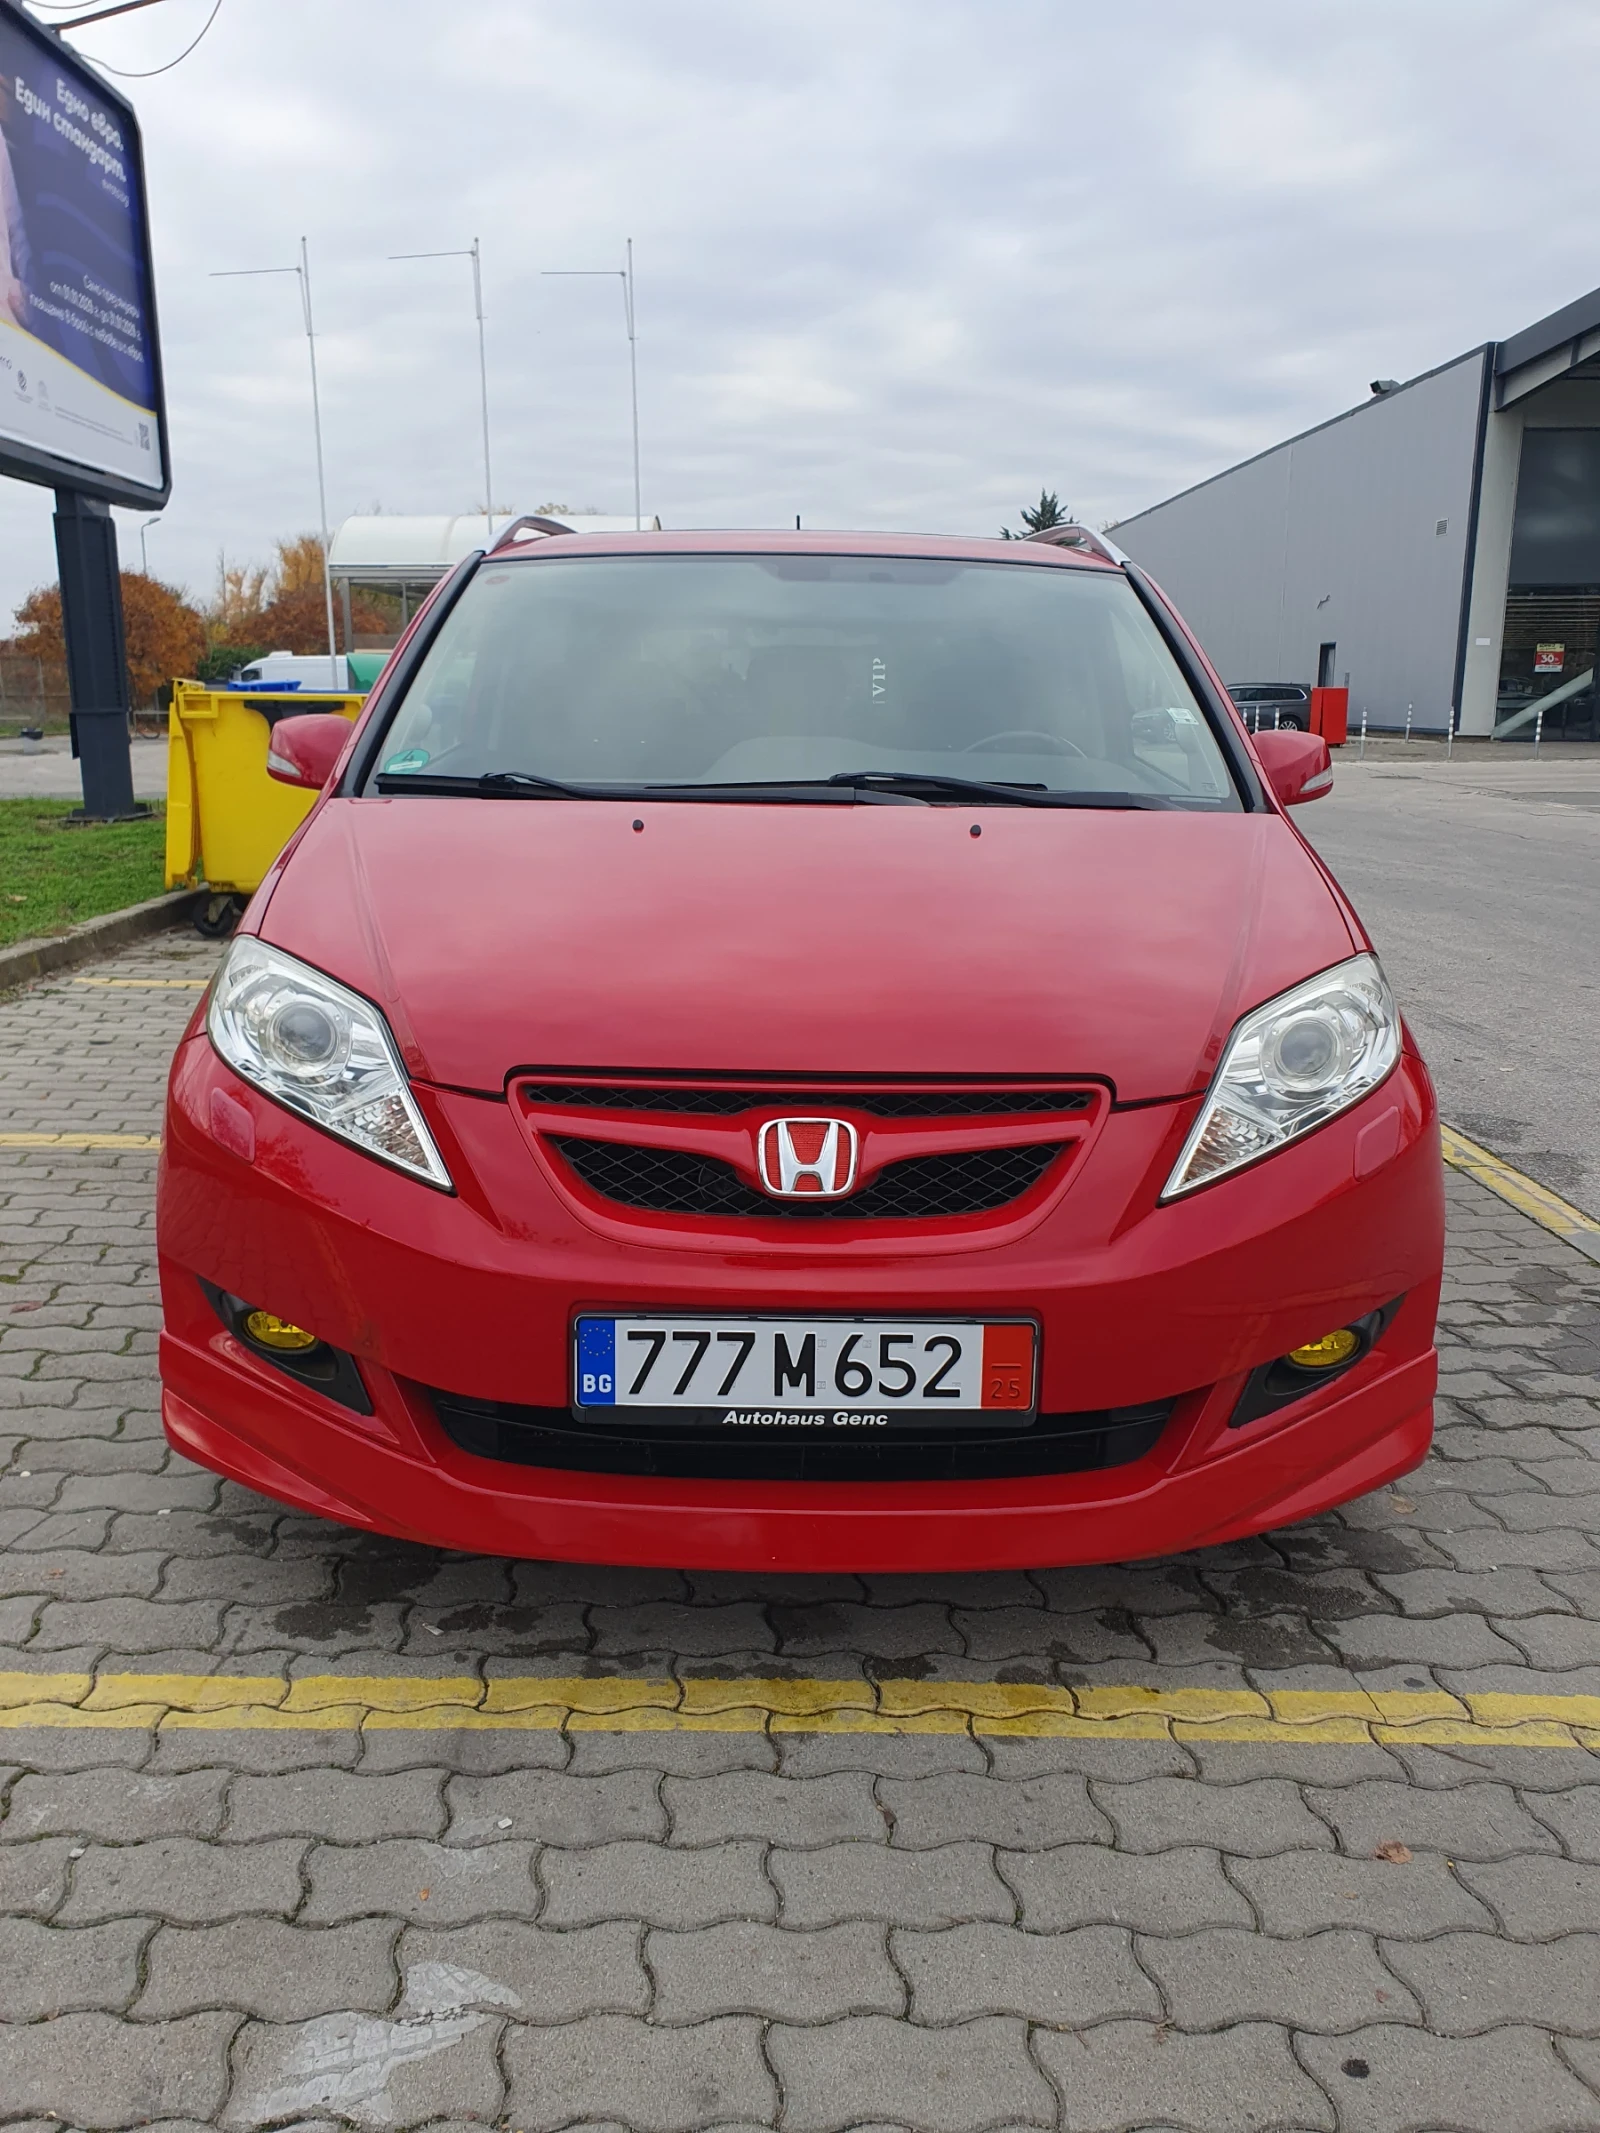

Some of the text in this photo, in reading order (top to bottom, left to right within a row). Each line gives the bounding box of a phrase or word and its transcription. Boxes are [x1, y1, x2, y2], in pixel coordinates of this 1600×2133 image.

[56, 78, 89, 122] Едно
[15, 76, 127, 182] Един стандарт.
[872, 657, 886, 697] VIP
[583, 1373, 612, 1393] BG
[627, 1330, 962, 1398] 777 M 652
[991, 1378, 1021, 1399] 25
[722, 1410, 889, 1426] Autohaus Genc
